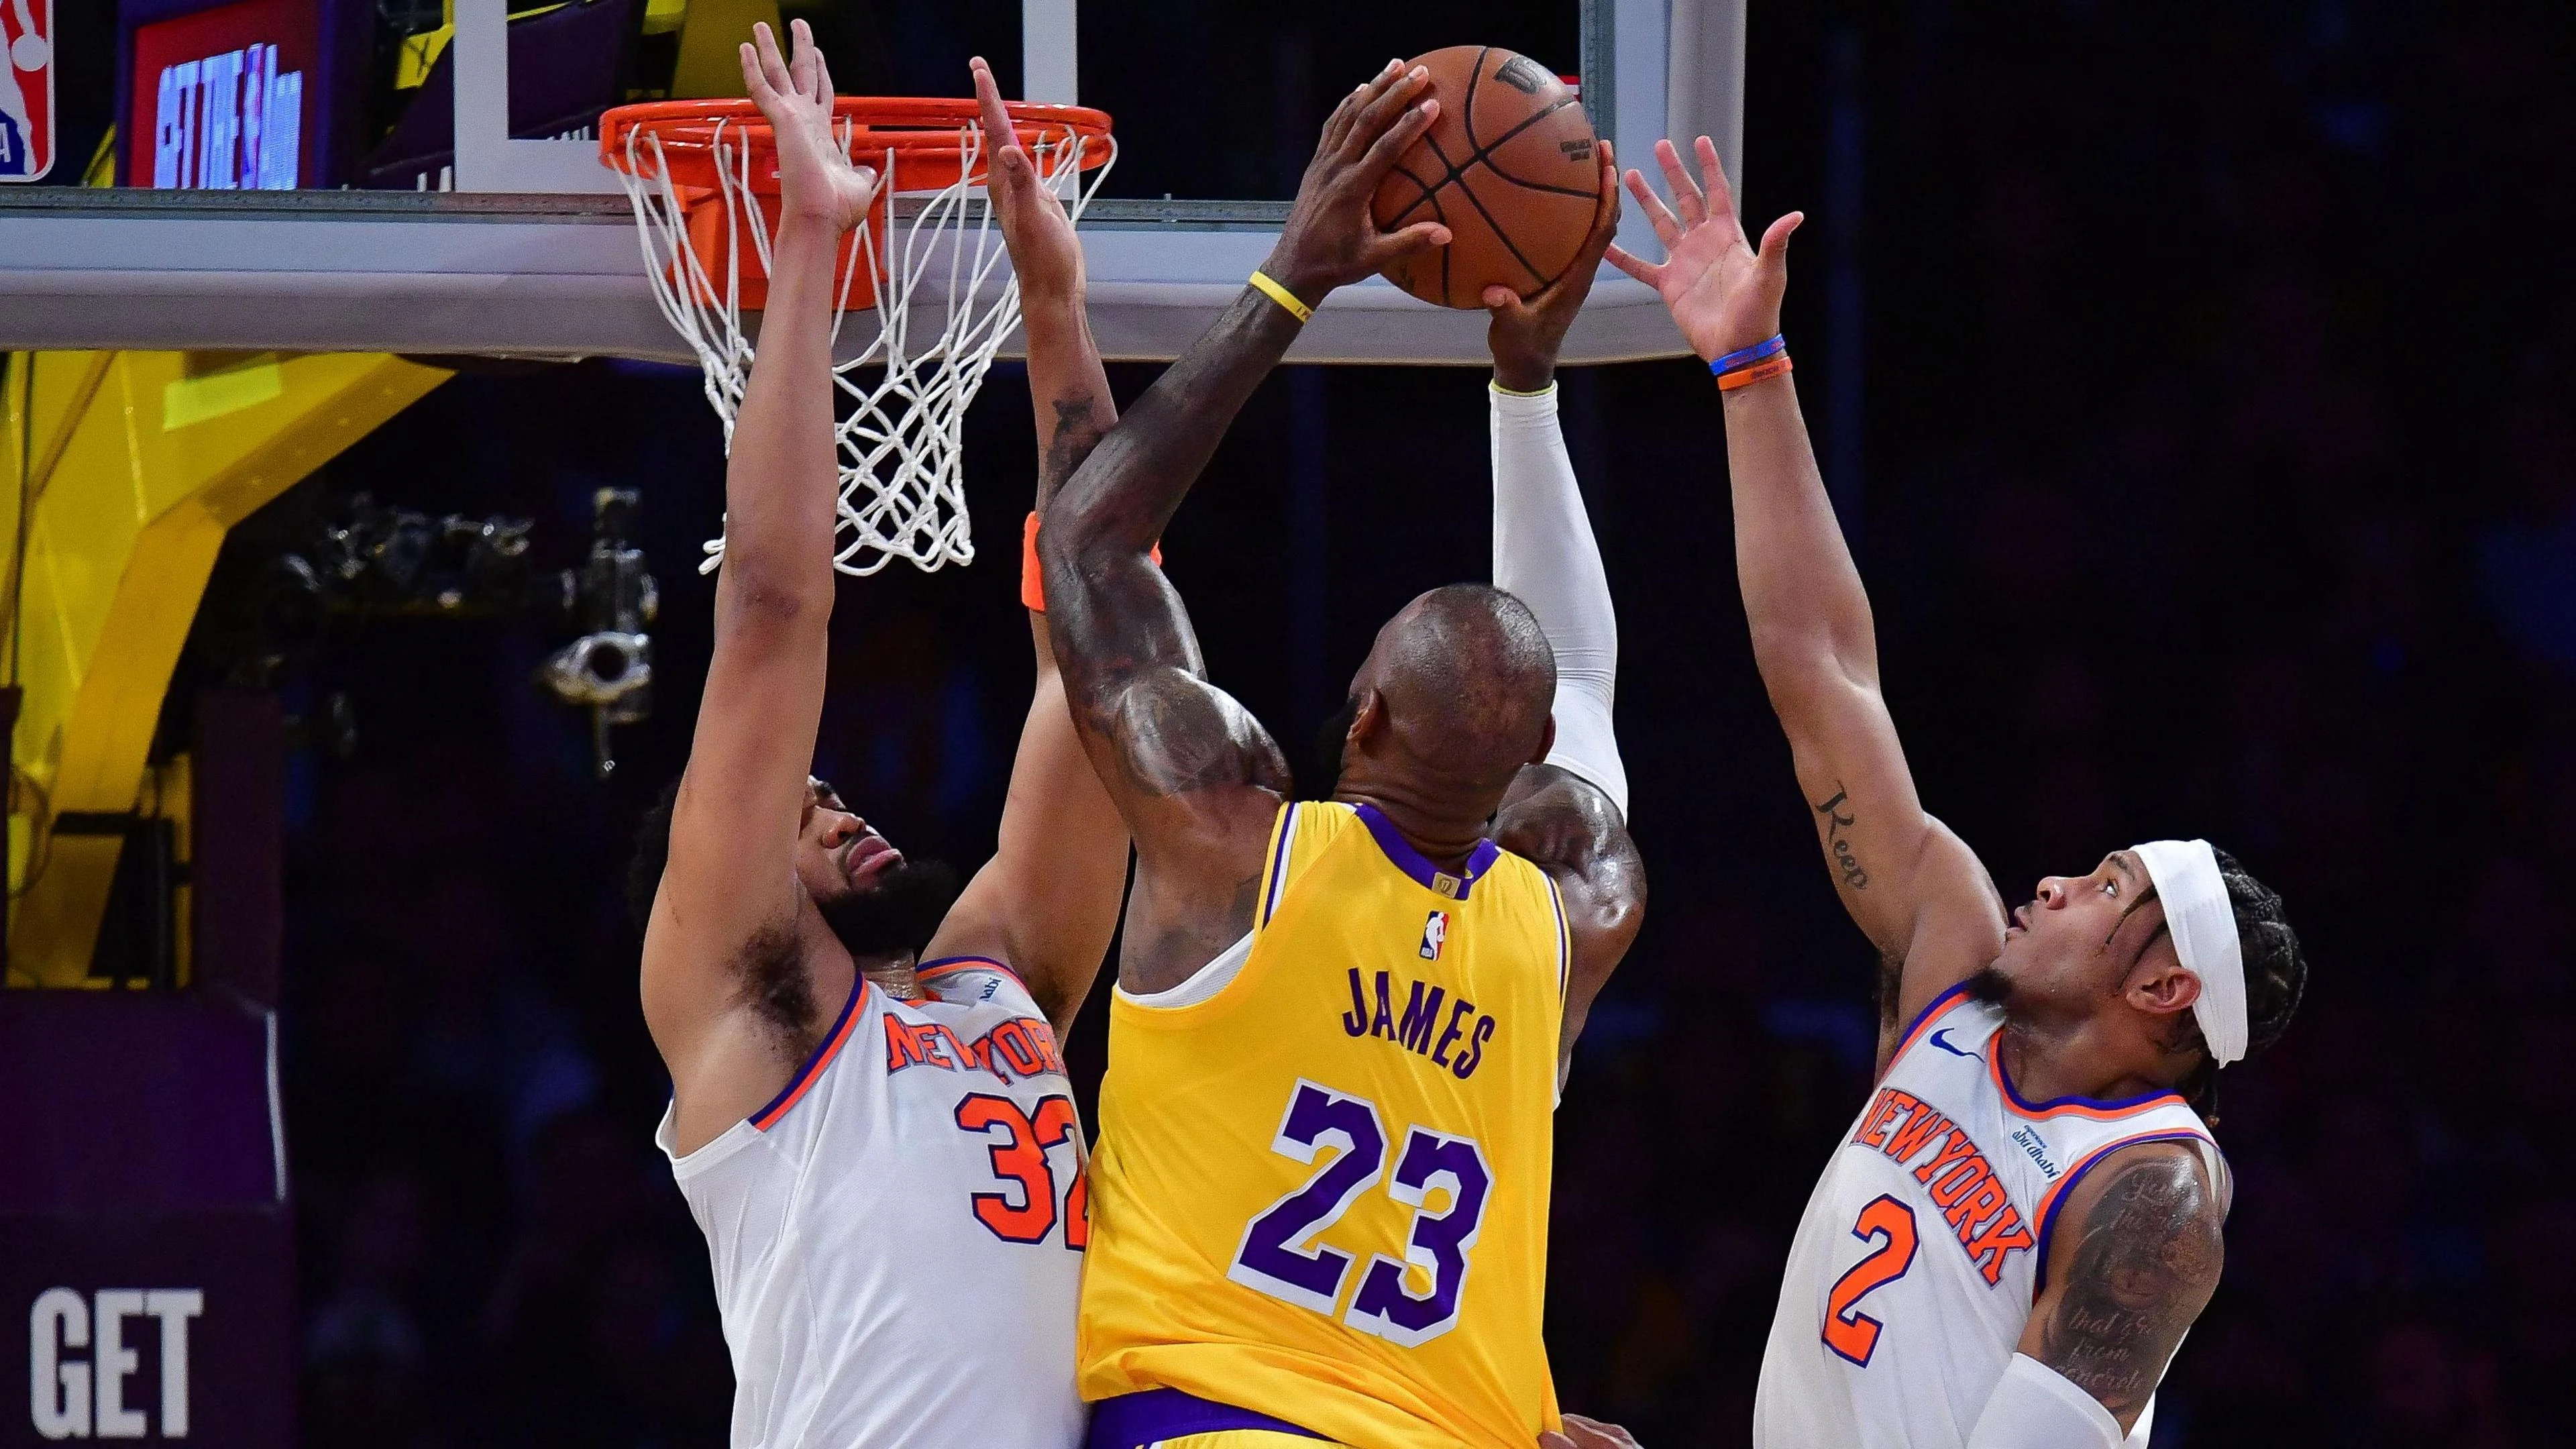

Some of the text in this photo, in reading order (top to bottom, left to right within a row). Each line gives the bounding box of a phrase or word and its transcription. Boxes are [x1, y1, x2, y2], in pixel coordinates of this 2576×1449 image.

[1815, 780, 1868, 889] Keep
[1342, 967, 1495, 1079] JAMES
[953, 1092, 1089, 1252] 32
[1226, 1077, 1495, 1348] 23
[1849, 1087, 2037, 1290] NEW YORK
[2012, 1131, 2061, 1179] abu dhabi
[1821, 1193, 1920, 1368] 2
[30, 1287, 203, 1439] GET
